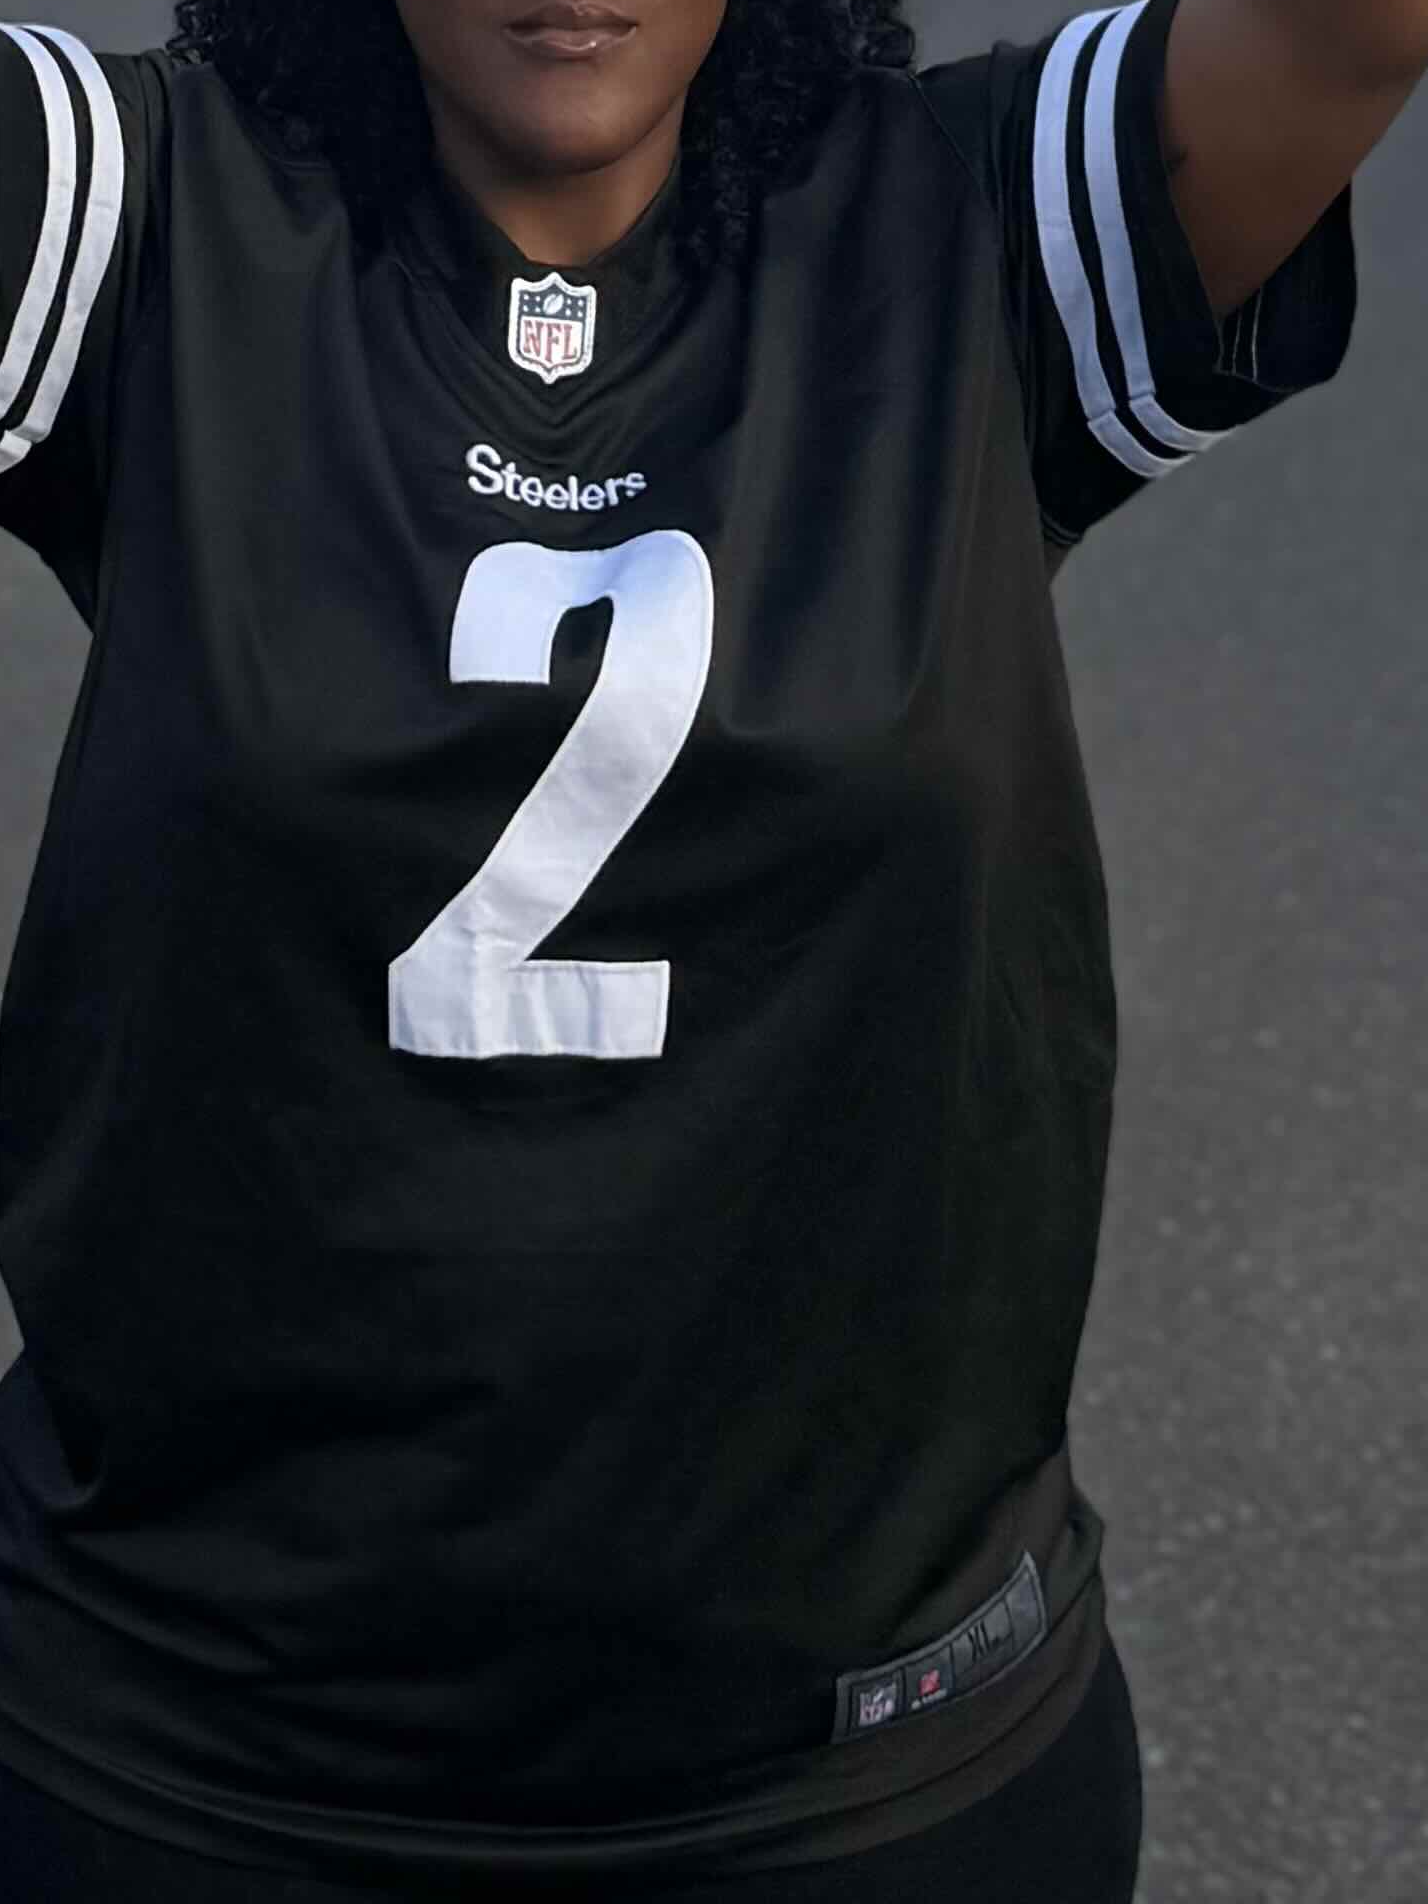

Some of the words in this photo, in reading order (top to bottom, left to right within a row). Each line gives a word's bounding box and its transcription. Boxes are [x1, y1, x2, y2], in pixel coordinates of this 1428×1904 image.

[523, 319, 578, 364] NFL
[465, 443, 648, 512] Steelers
[388, 529, 715, 1059] 2
